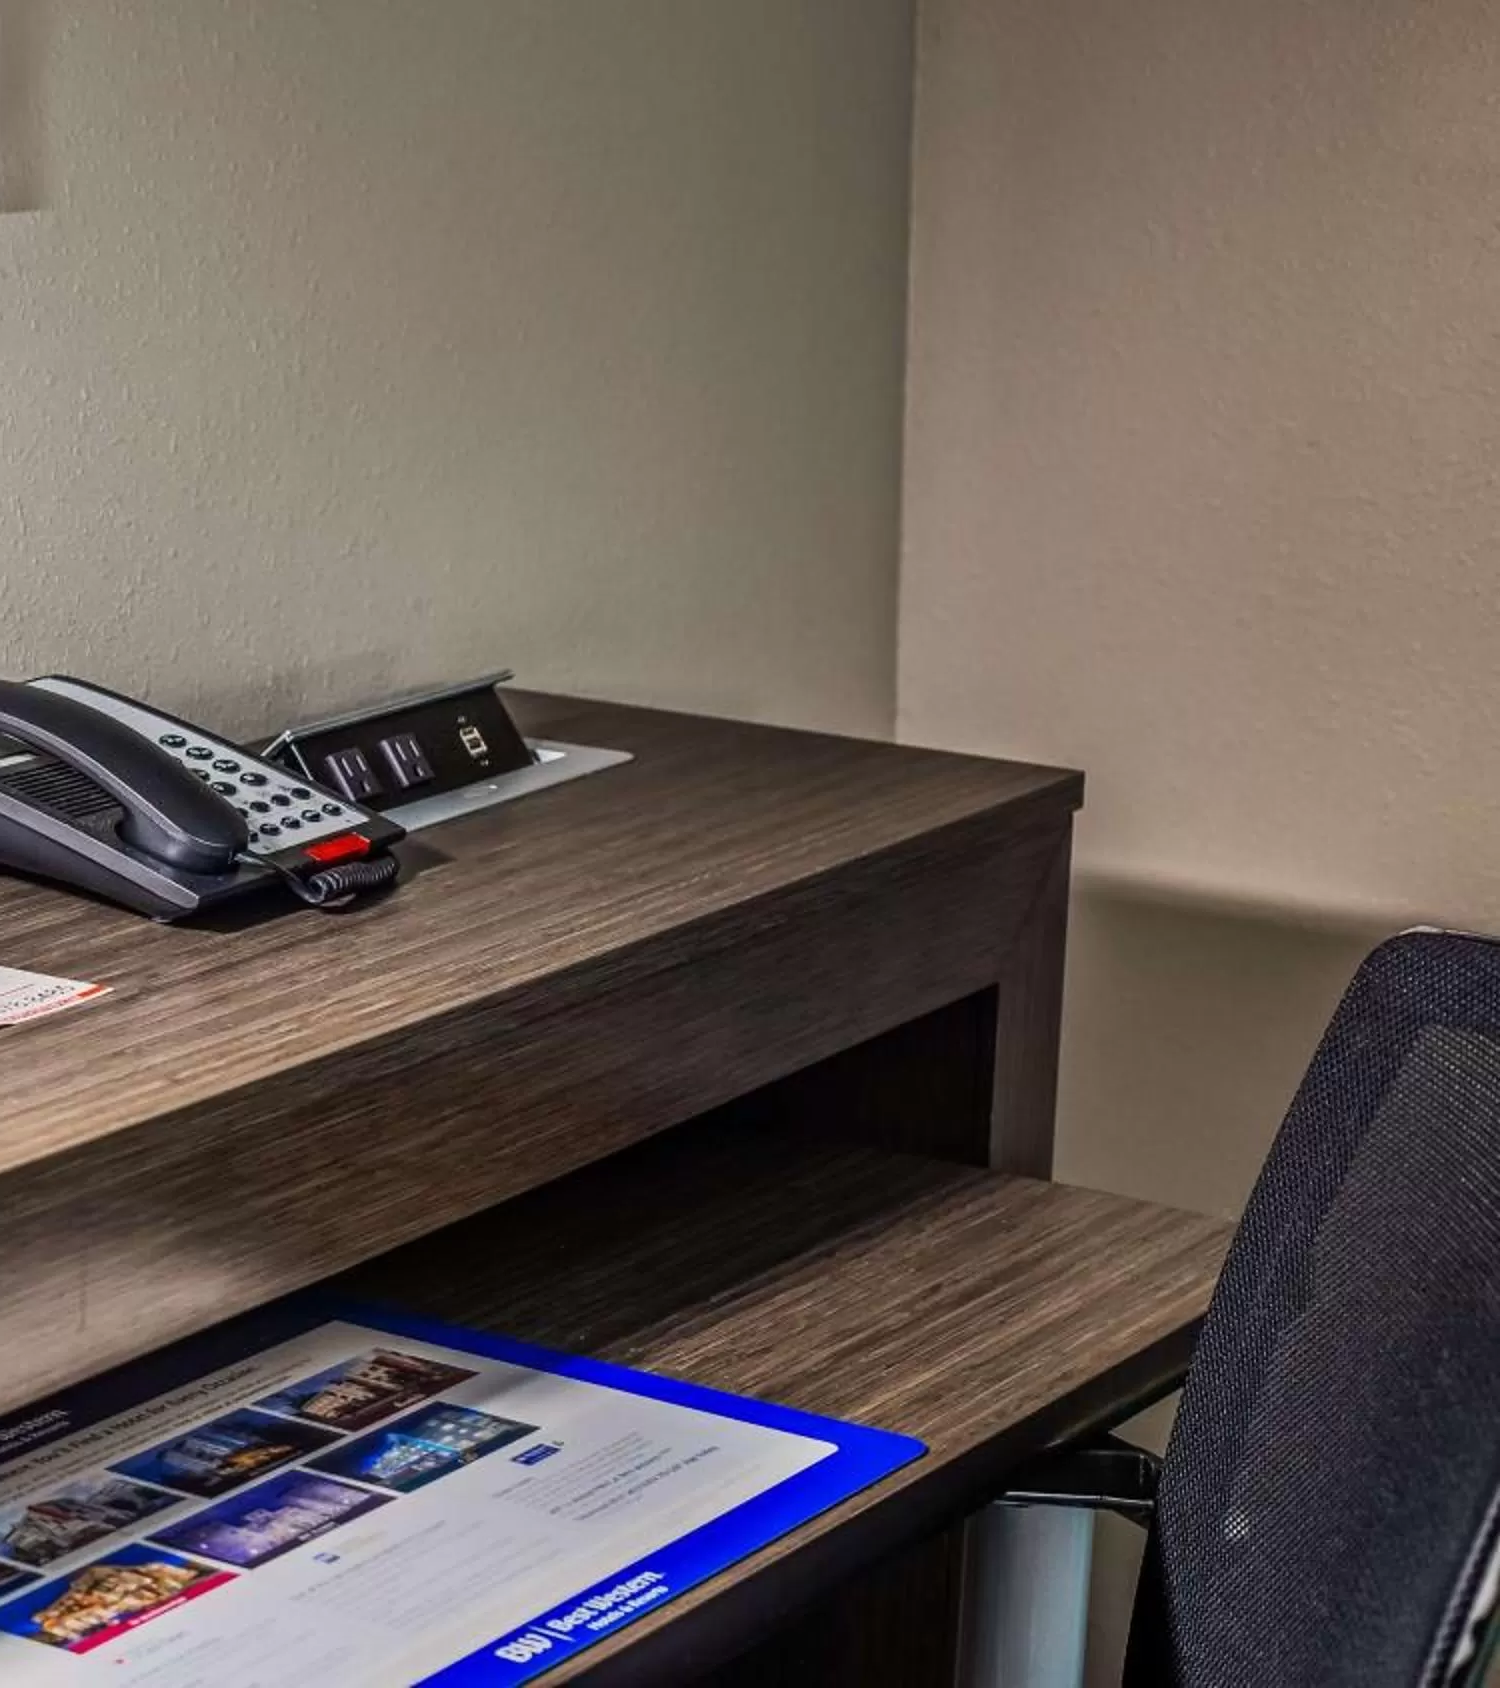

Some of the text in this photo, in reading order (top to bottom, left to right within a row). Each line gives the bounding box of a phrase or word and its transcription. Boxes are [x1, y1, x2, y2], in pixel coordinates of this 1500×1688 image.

[494, 1571, 666, 1664] BW Best Western
[586, 1611, 625, 1631] Hotels
